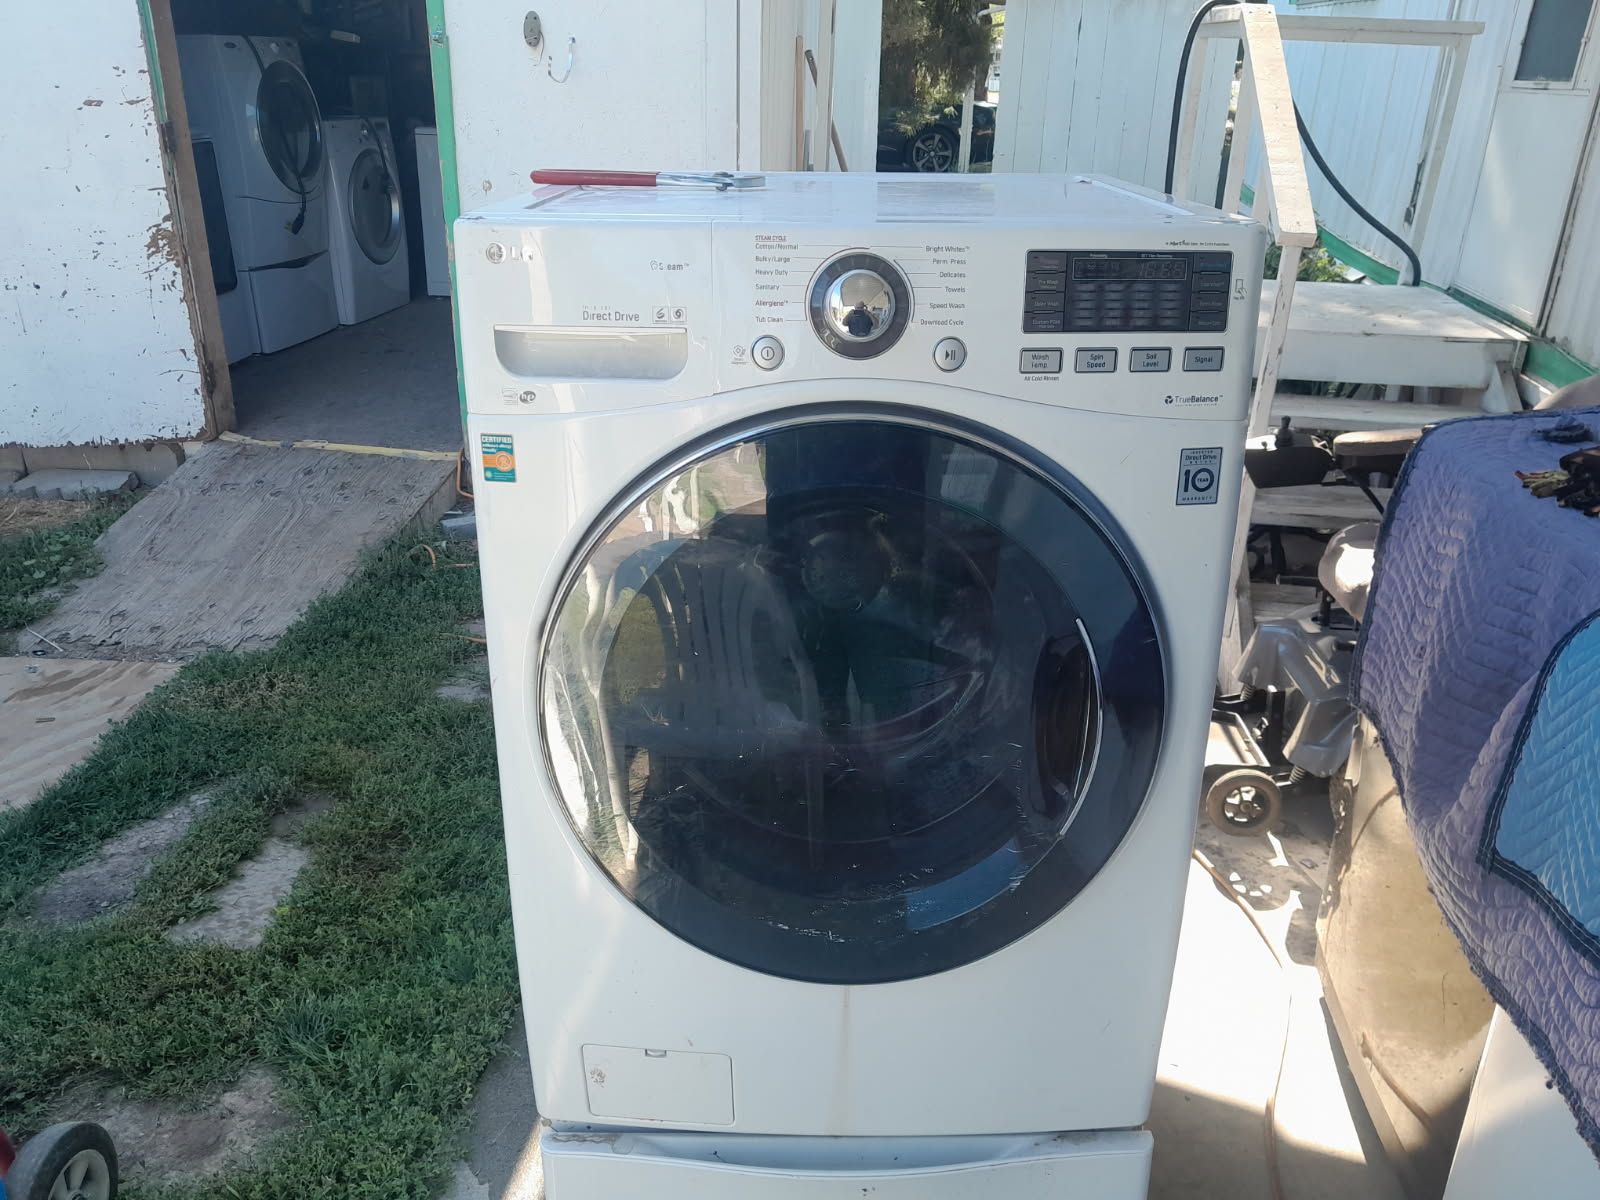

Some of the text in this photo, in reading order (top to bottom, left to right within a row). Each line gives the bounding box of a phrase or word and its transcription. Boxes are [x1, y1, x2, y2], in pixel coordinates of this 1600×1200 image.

[926, 245, 944, 253] Bright
[582, 310, 640, 322] Direct Drive
[1090, 353, 1104, 361] Spin
[1184, 468, 1215, 492] 10
